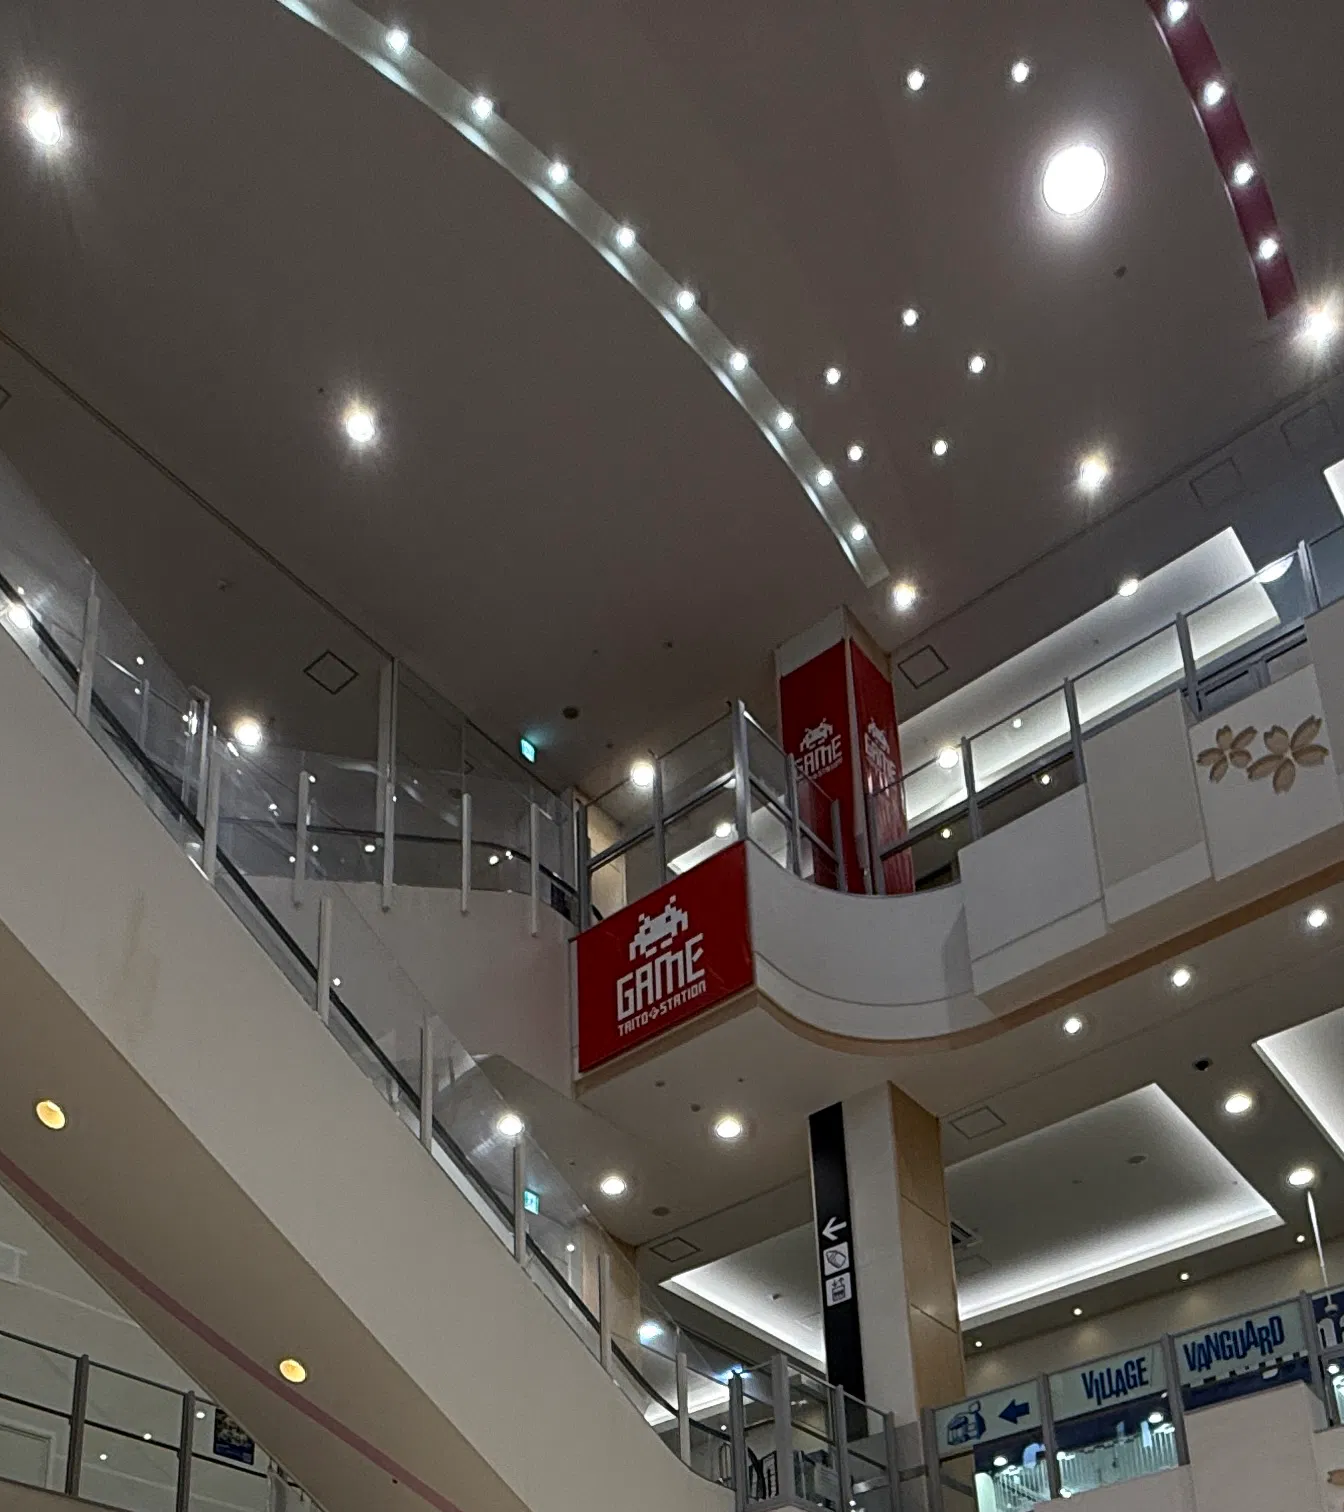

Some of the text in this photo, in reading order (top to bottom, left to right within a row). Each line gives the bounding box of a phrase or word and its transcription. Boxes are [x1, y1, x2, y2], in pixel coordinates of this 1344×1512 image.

[794, 734, 843, 783] GAME
[616, 932, 705, 1021] GAME
[618, 981, 706, 1037] TAITO STATION
[1081, 1314, 1285, 1406] VILLAGE VANGUARD
